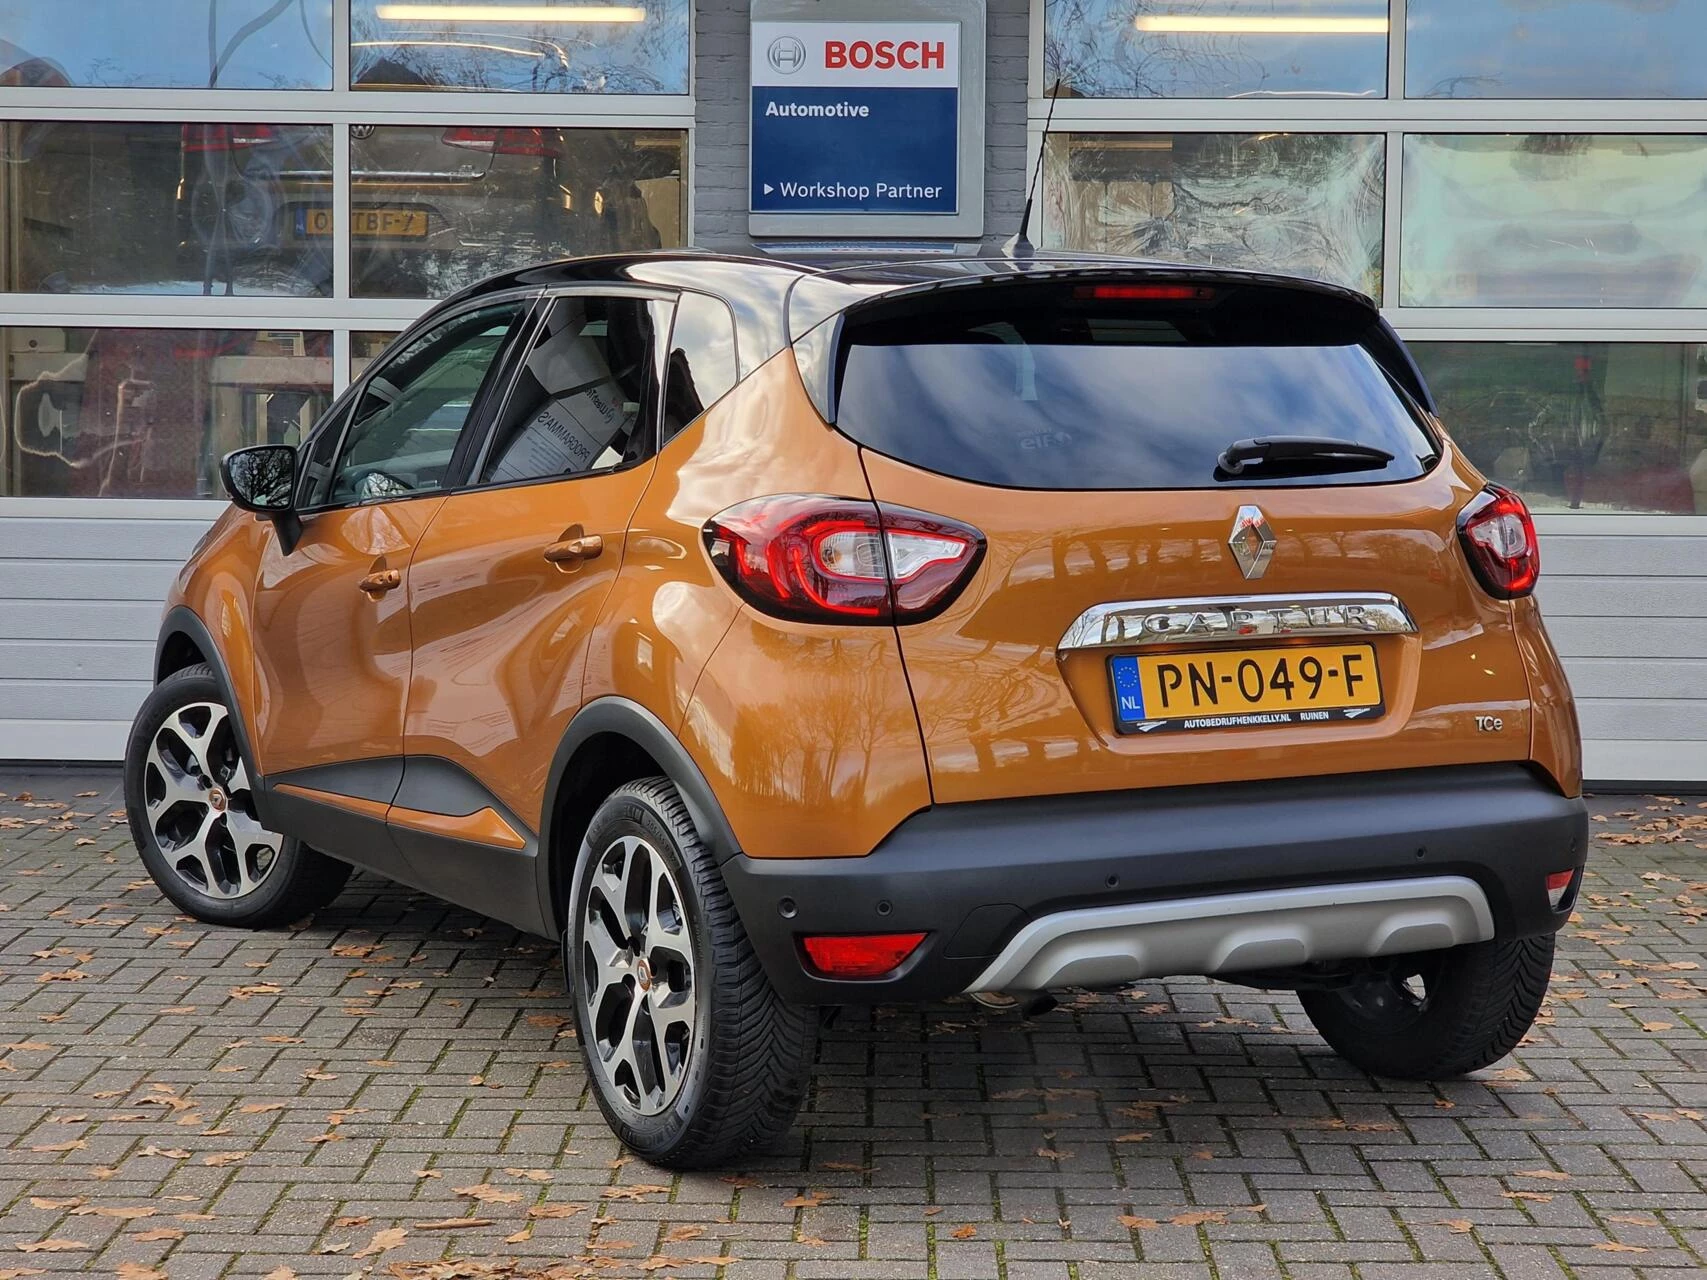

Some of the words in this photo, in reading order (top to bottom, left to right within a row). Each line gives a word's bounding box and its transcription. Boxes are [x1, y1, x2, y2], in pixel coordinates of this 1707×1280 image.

[825, 41, 945, 69] BOSCH
[765, 101, 870, 117] Automotive
[780, 183, 870, 200] Workshop
[876, 183, 943, 198] Partner
[314, 211, 415, 231] 0TBF-7
[1145, 604, 1369, 634] CAPTUR
[1156, 654, 1364, 708] PN-049-F
[1122, 696, 1141, 711] NL
[1184, 712, 1292, 729] AUTOBEDRIJFHENKKELLY.NL
[1300, 711, 1329, 721] RUINEN
[1475, 715, 1503, 732] TCe
